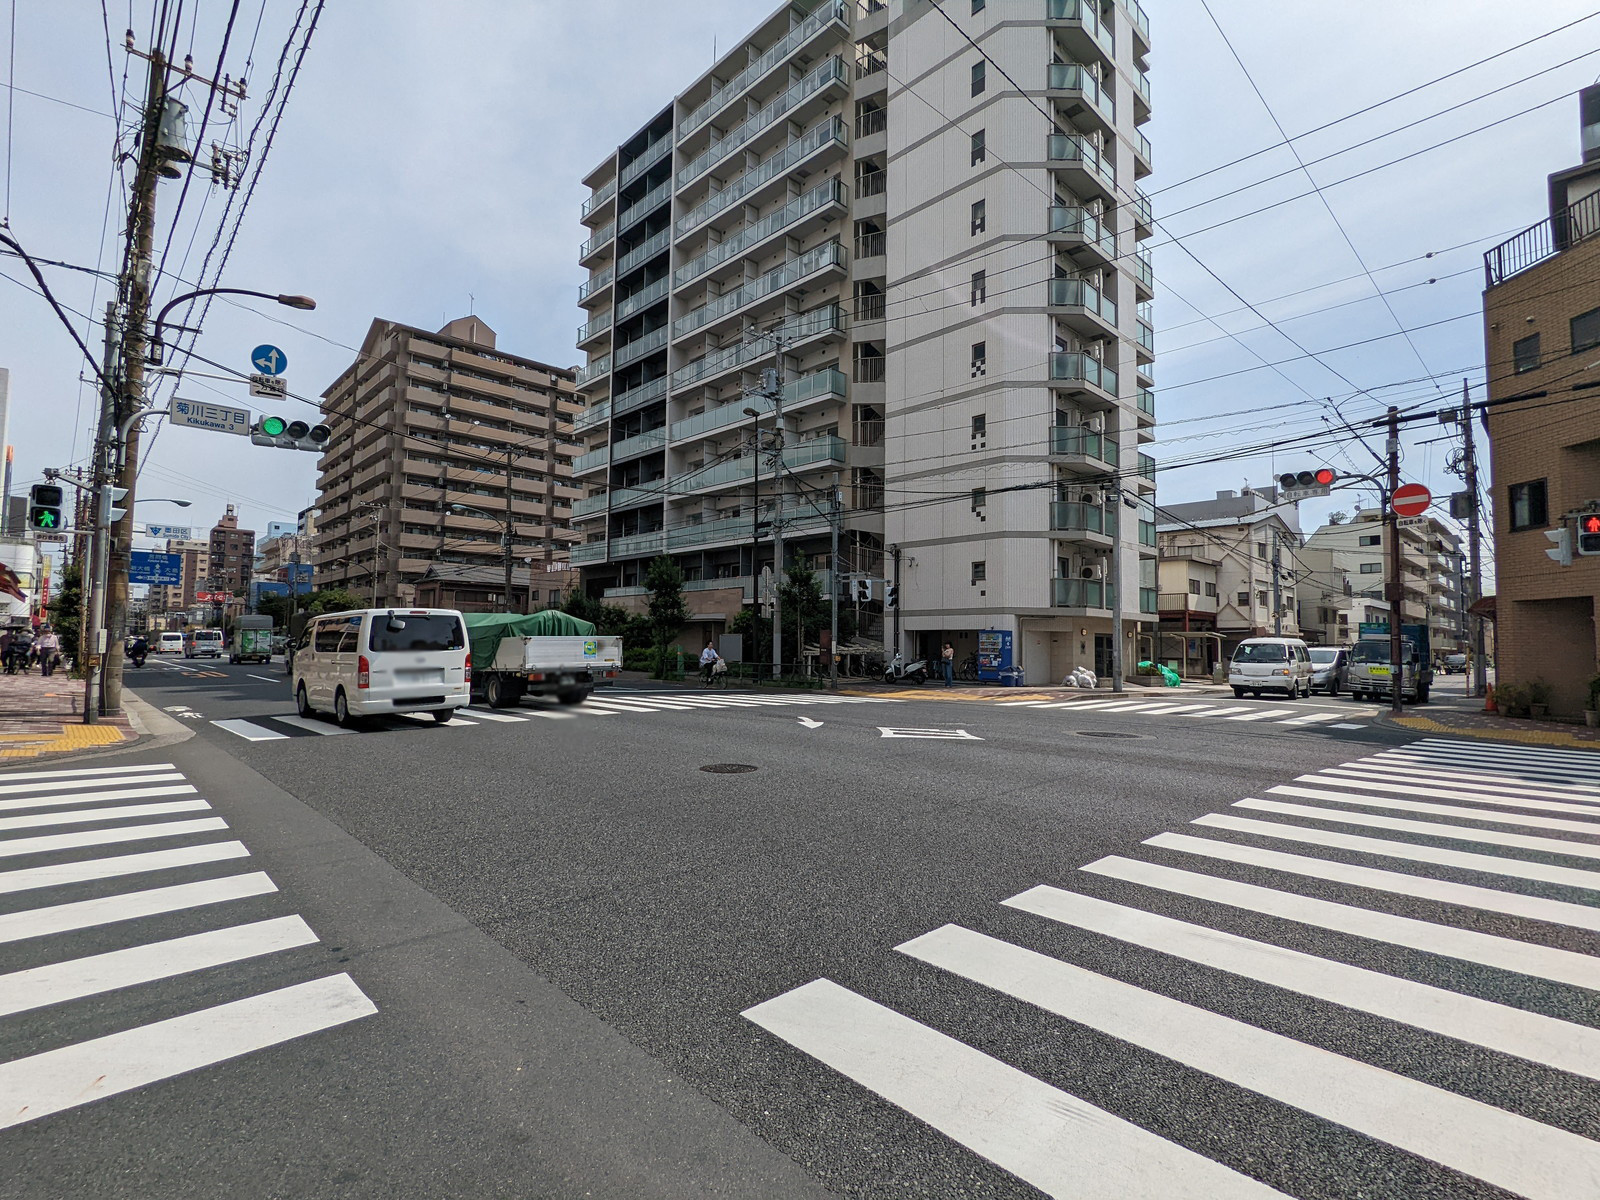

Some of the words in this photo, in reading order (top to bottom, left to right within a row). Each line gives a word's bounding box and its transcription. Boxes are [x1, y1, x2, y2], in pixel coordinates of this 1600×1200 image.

[176, 402, 245, 424] 菊川三丁目
[187, 417, 226, 429] Kikukawa
[229, 423, 235, 431] 3
[1287, 488, 1328, 498] 自転車専用
[1398, 518, 1426, 527] 自転車を除く
[164, 527, 188, 535] 墨田区
